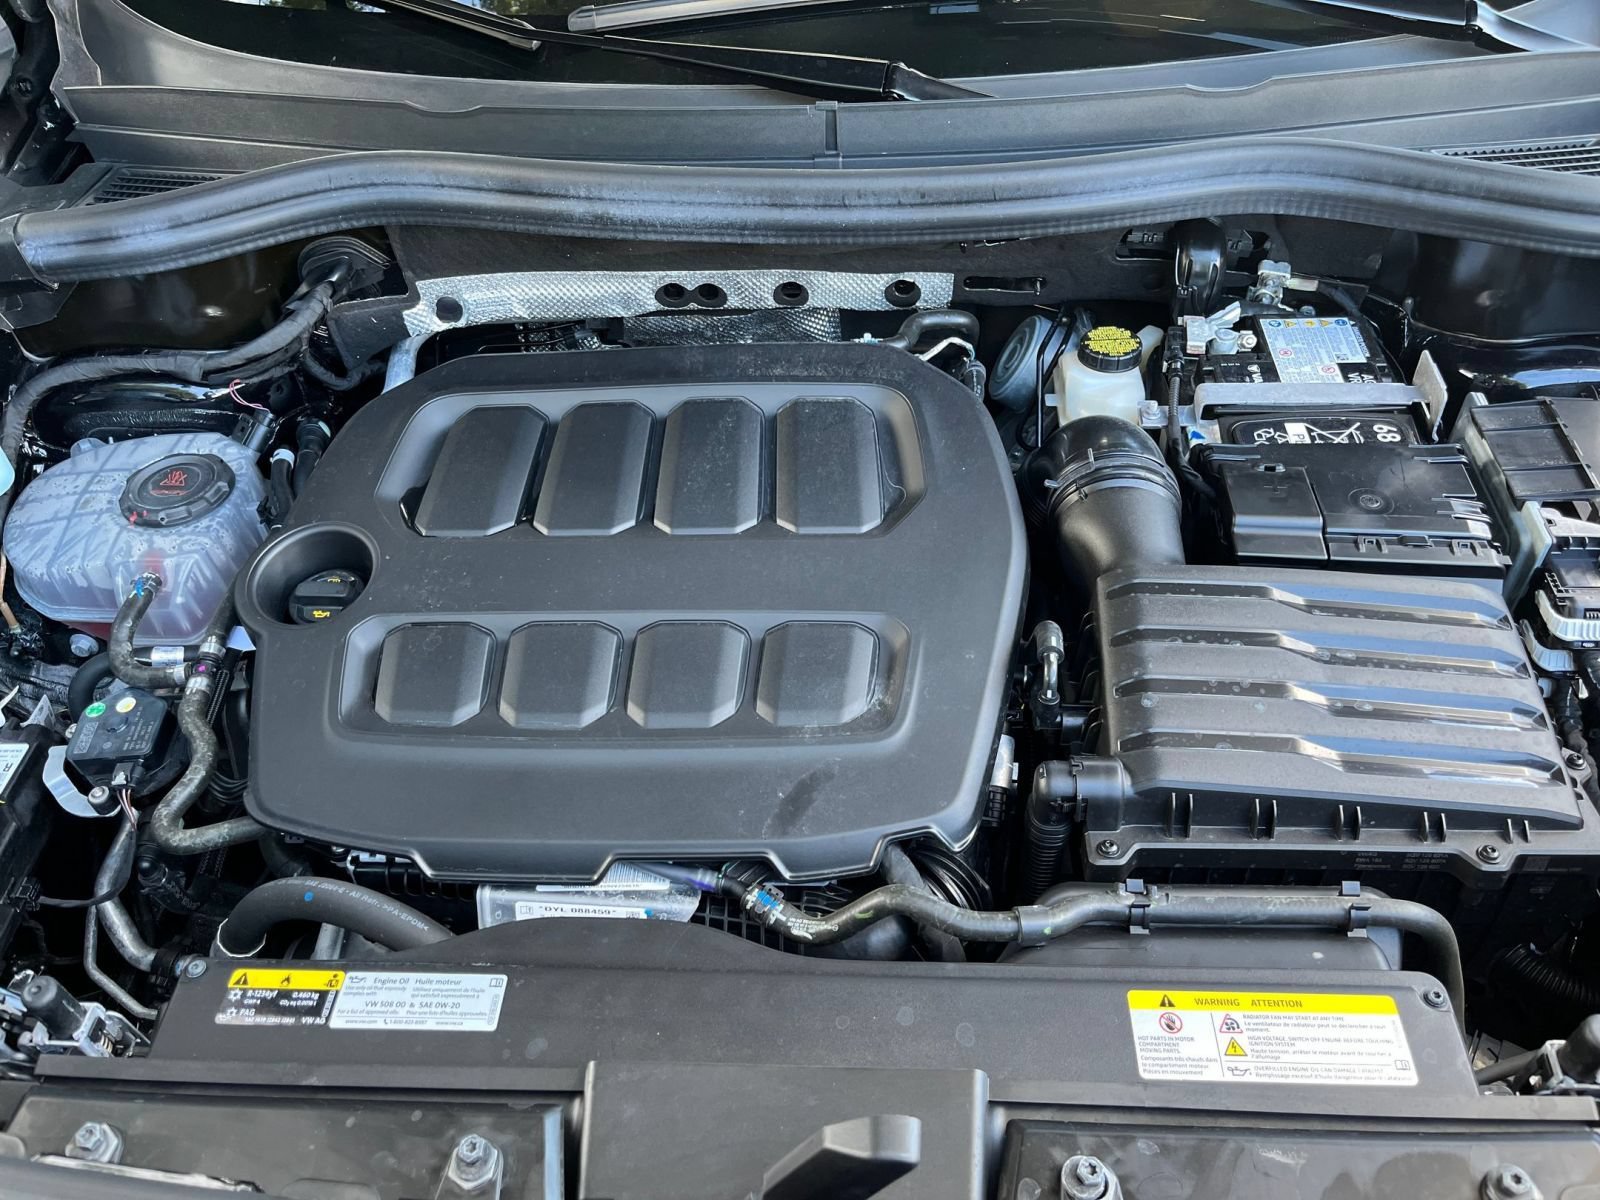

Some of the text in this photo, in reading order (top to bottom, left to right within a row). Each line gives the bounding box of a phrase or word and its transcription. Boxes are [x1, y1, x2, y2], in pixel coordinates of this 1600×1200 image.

[373, 977, 462, 986] Engine Oil Huile moteur
[365, 1000, 379, 1008] VW
[1194, 997, 1303, 1009] WARNING ATTENTION
[239, 1008, 256, 1016] PAG
